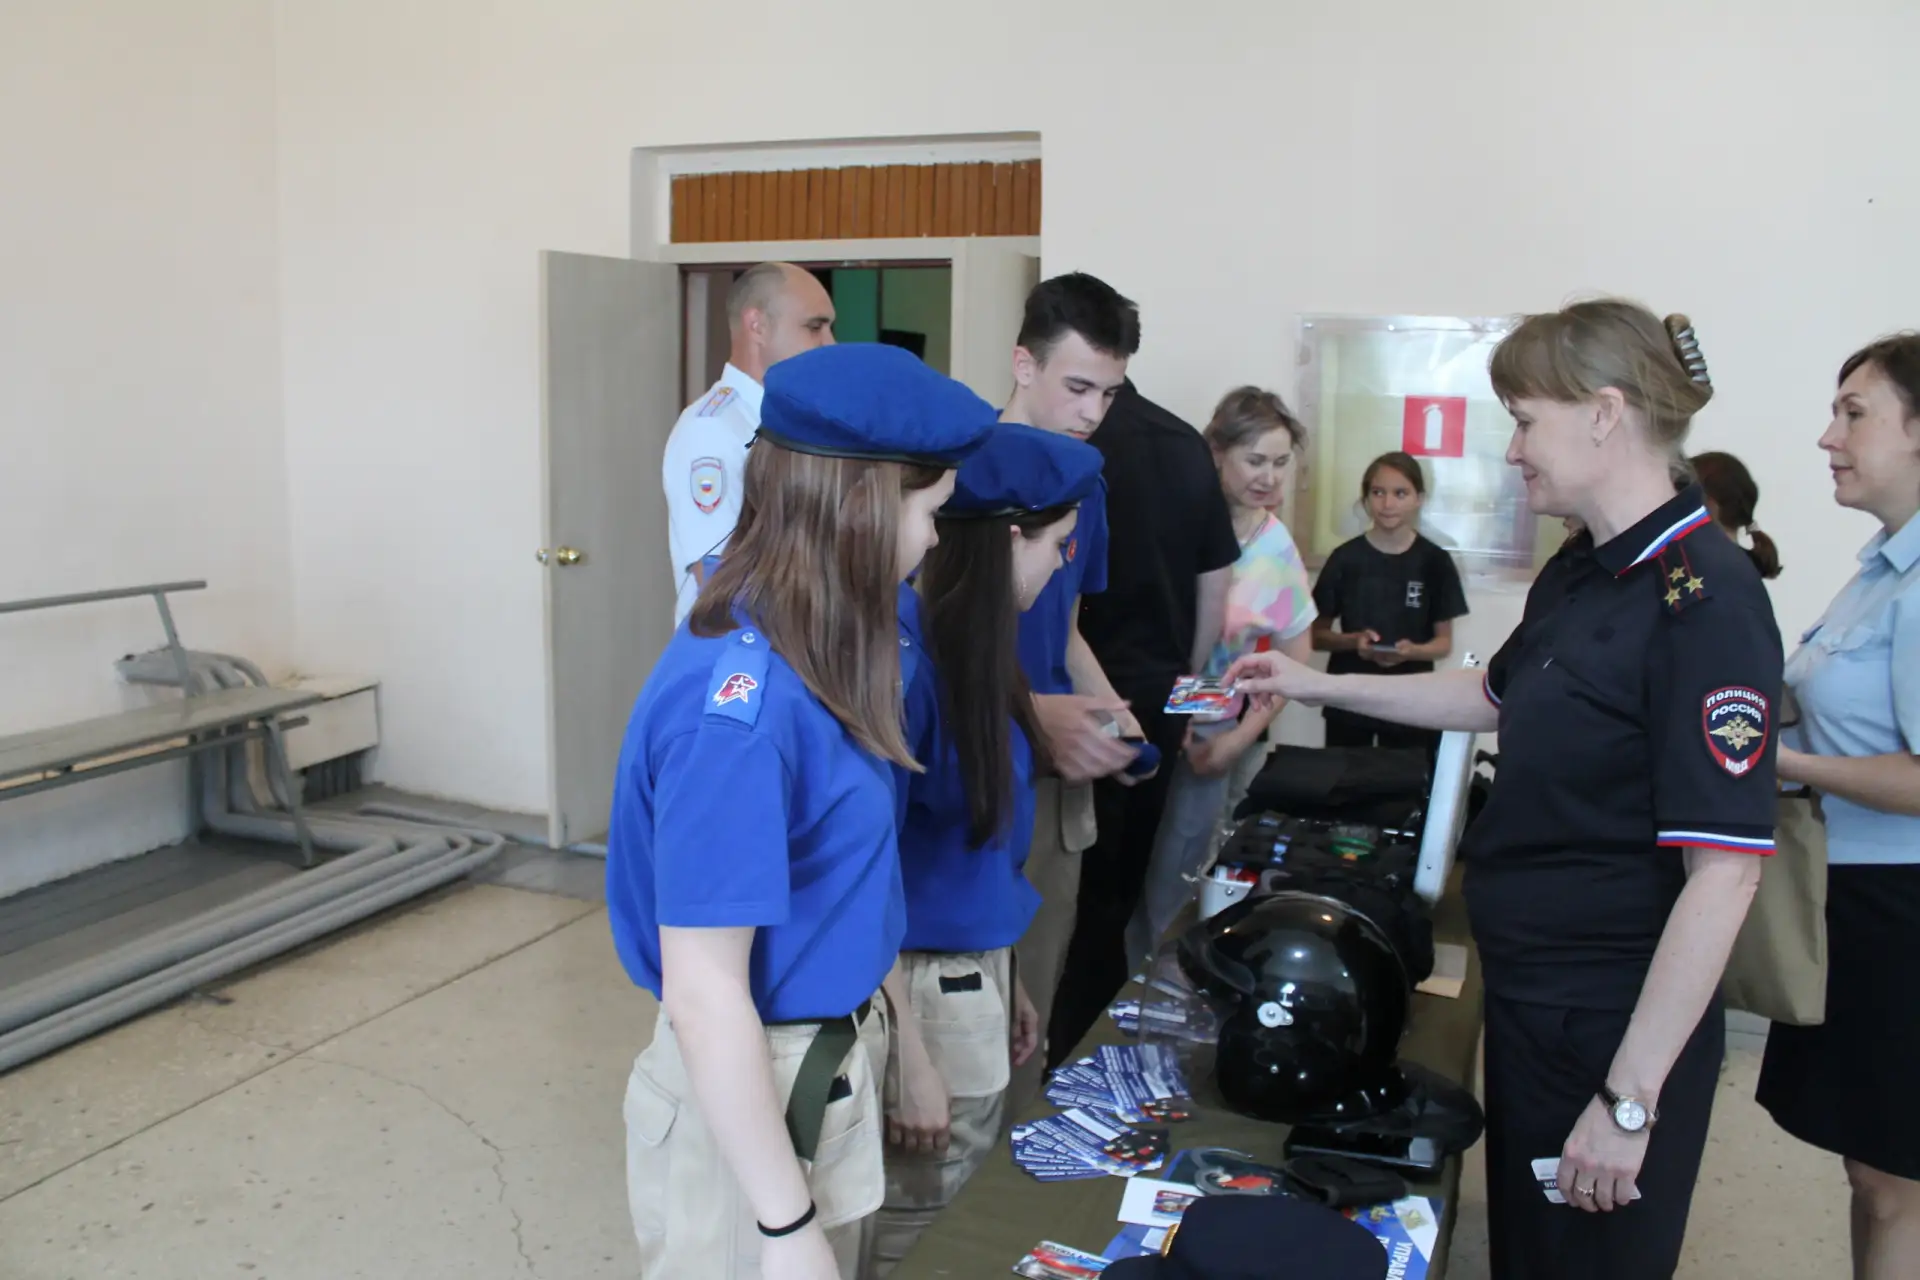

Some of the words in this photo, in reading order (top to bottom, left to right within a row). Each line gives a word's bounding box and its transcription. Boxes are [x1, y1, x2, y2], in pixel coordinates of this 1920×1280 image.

[1706, 689, 1766, 709] ПОЛИЦИЯ
[1711, 703, 1762, 722] РОССИЯ
[1725, 758, 1748, 774] МВД
